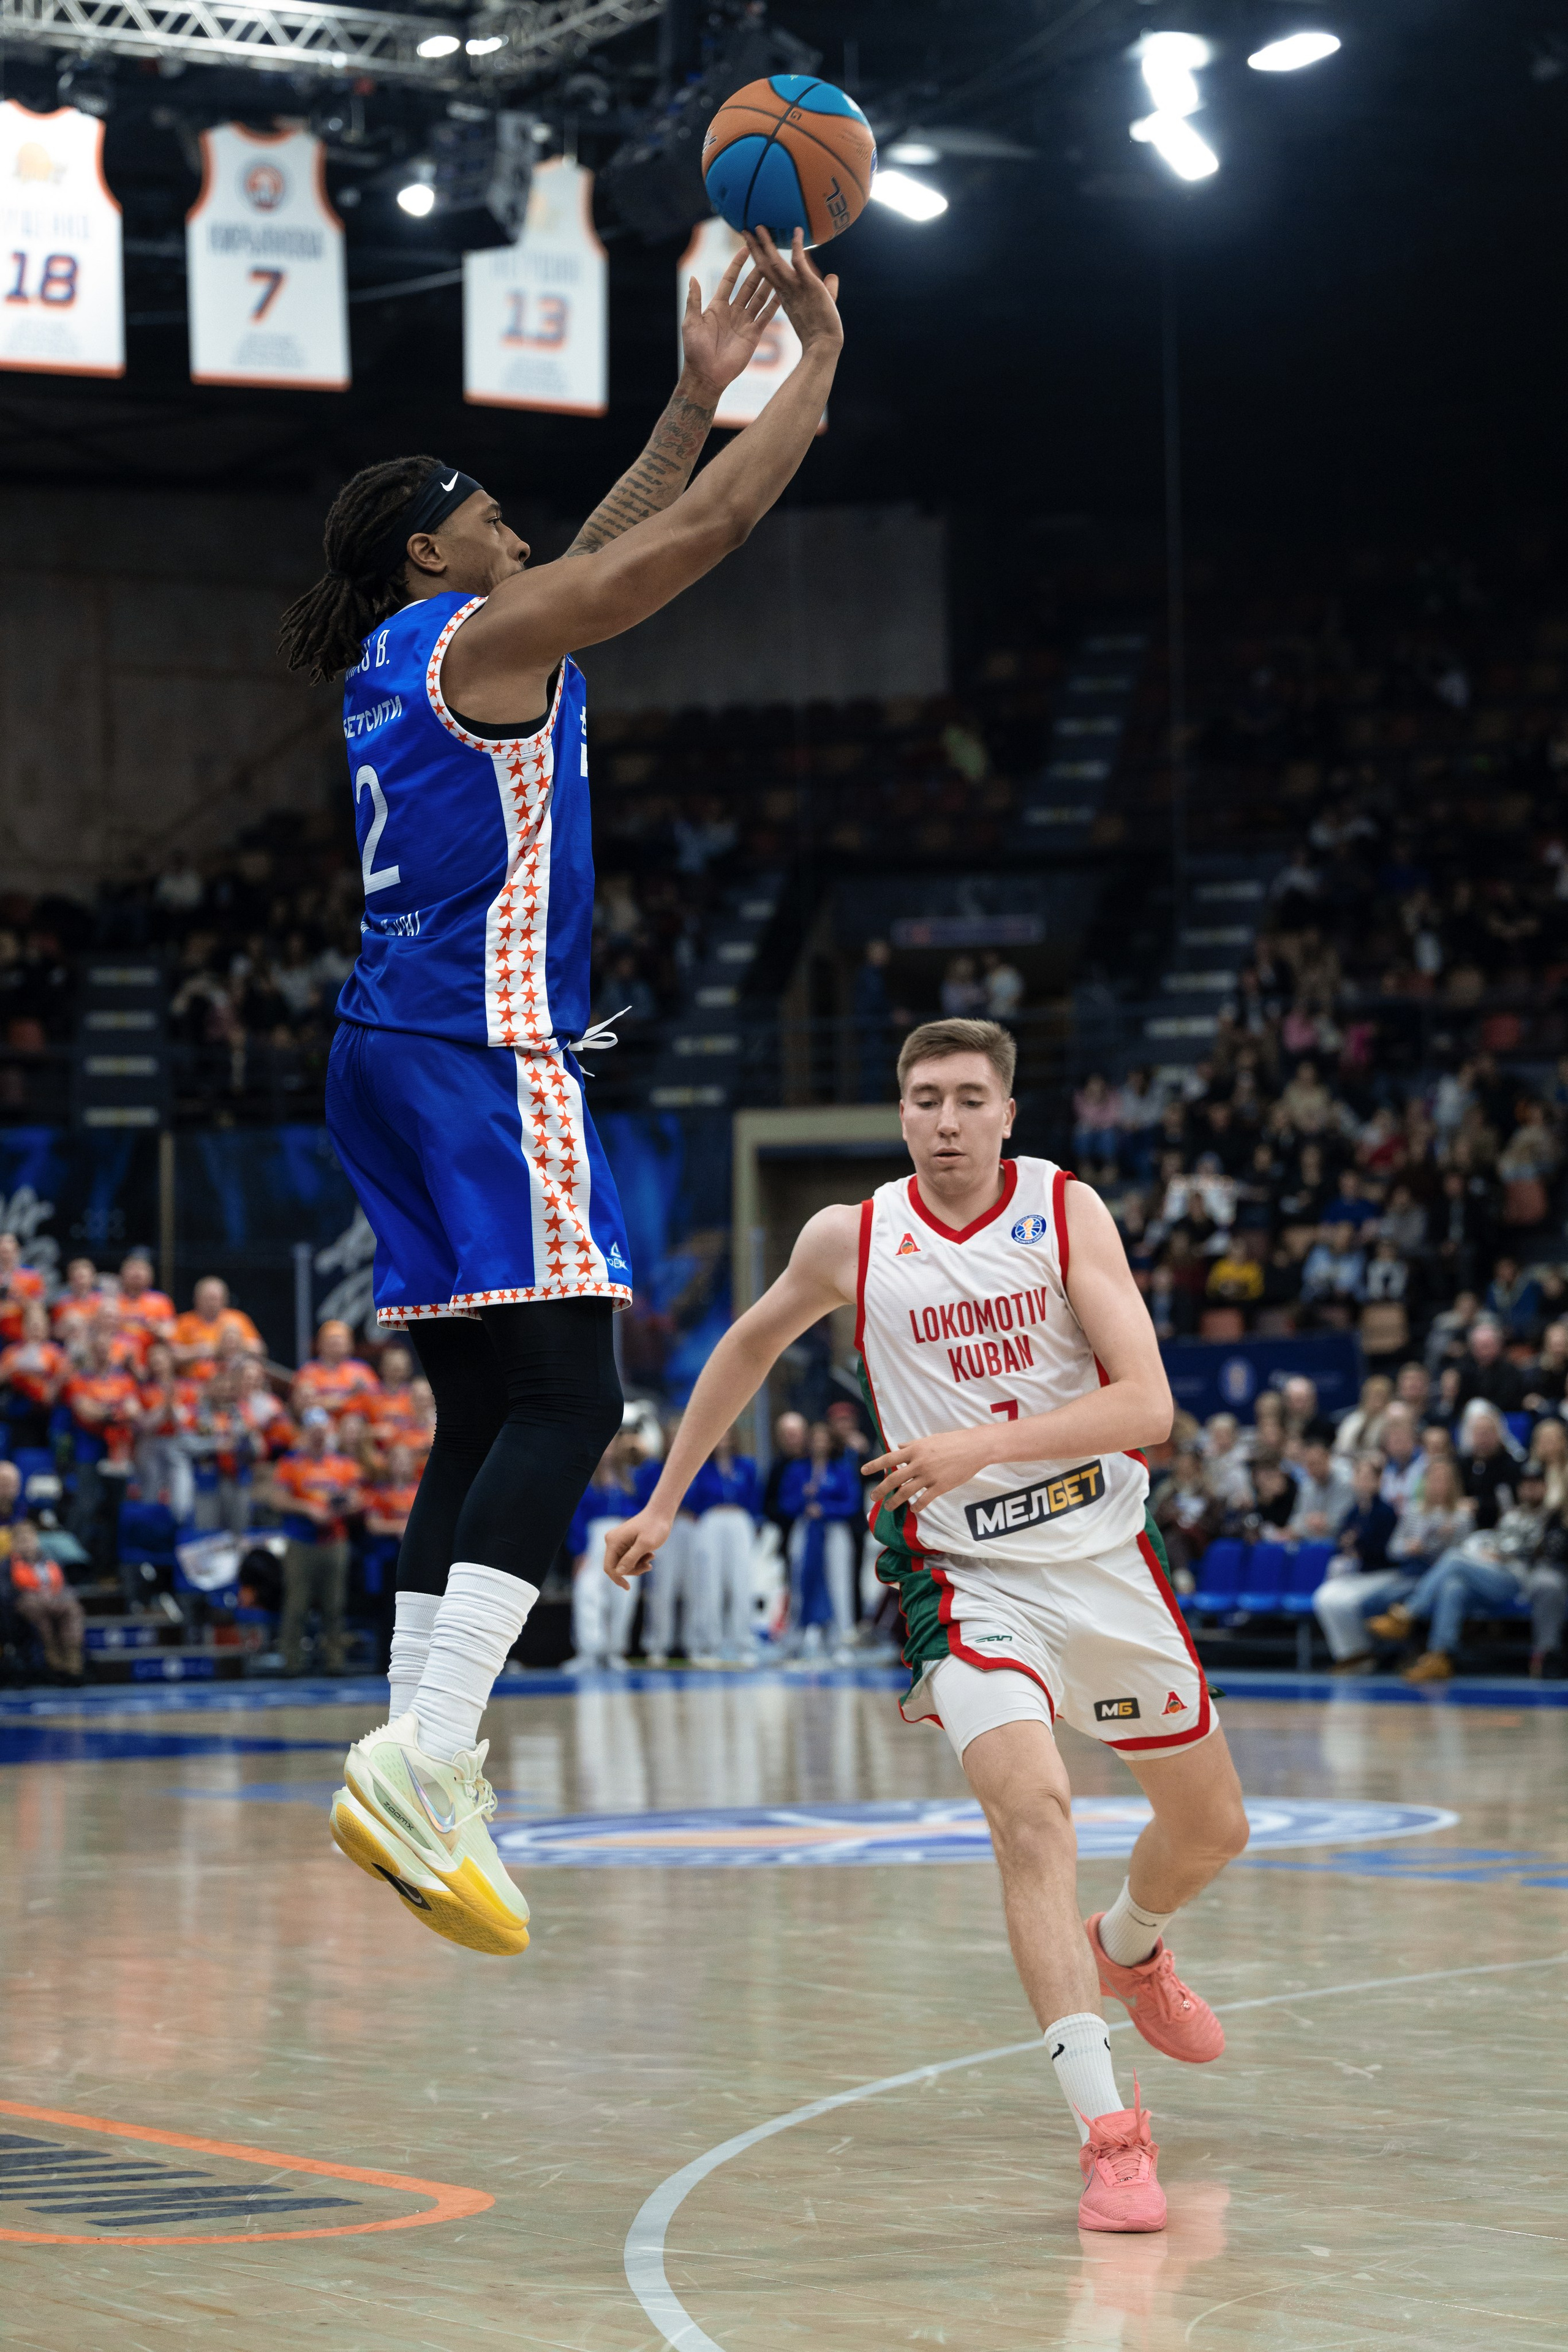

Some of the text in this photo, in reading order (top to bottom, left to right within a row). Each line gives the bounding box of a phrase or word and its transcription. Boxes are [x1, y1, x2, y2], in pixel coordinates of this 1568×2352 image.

[5, 251, 78, 309] 18
[250, 265, 287, 323] 7
[501, 288, 571, 352] 13
[356, 764, 401, 895] 2
[909, 1286, 1046, 1344] LOKOMOTIV
[947, 1335, 1034, 1383] KUBAN
[975, 1466, 1099, 1536] МЕЛБЕТ
